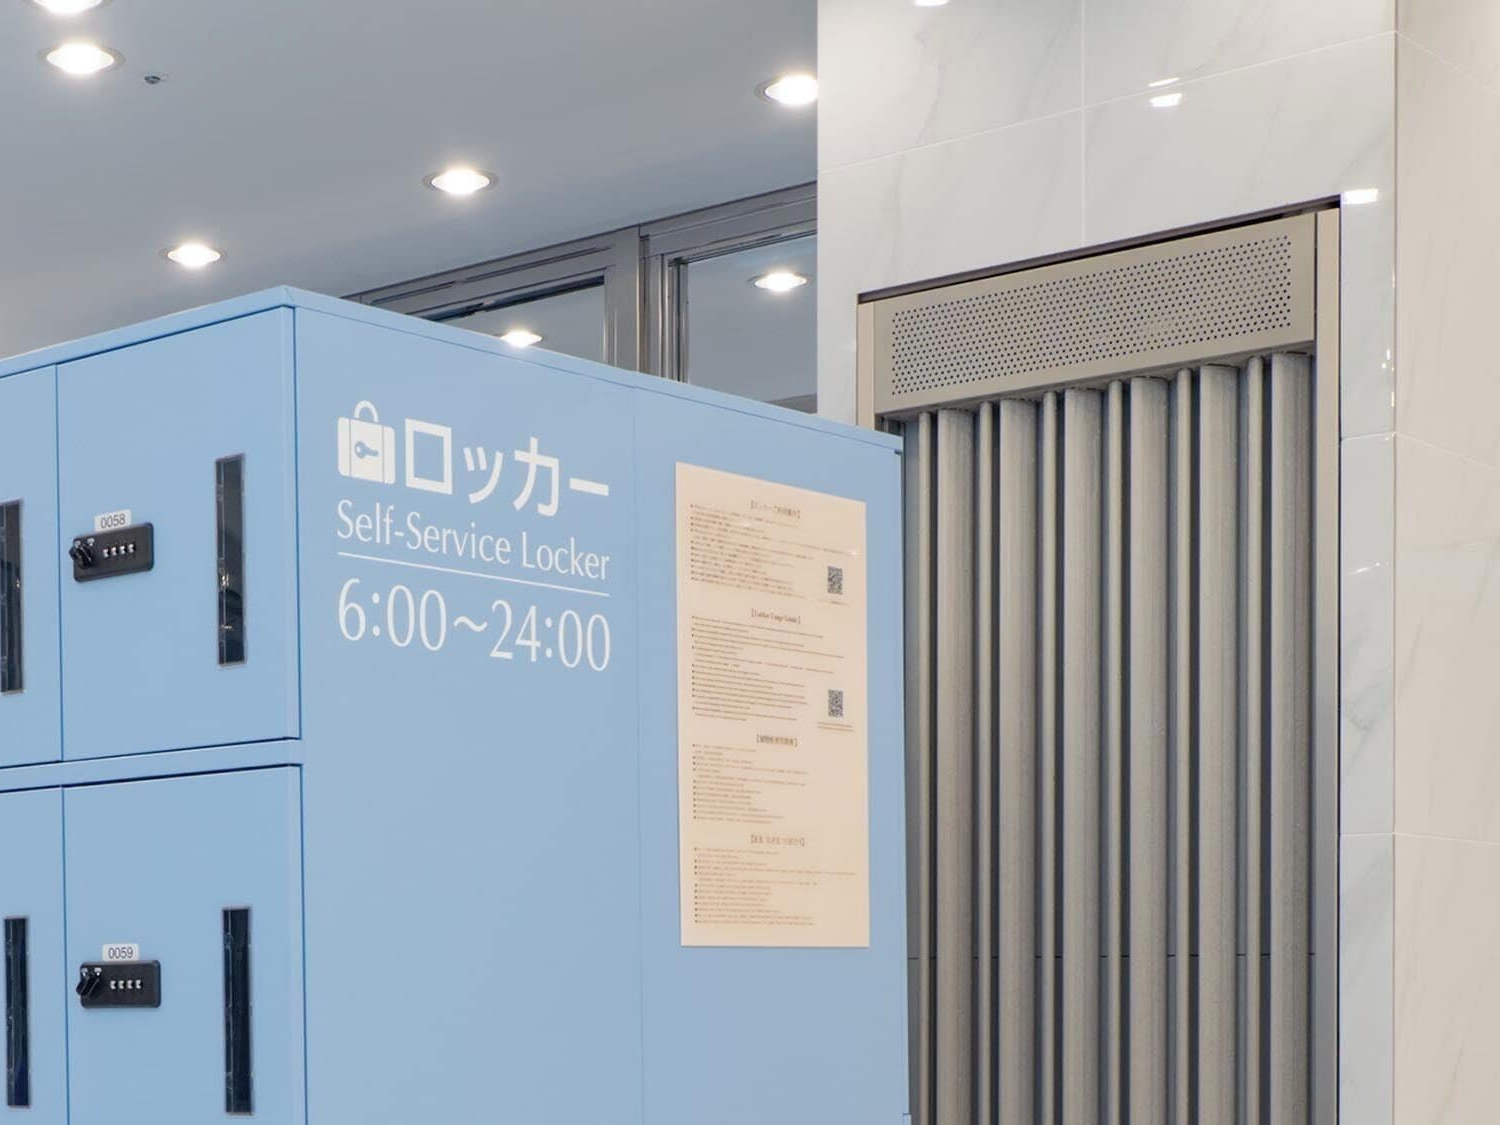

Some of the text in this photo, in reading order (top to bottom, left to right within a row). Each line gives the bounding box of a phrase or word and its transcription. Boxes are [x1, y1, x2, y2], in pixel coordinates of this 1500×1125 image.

[405, 418, 609, 517] ロッカー
[100, 513, 126, 528] 0058
[337, 499, 610, 580] Self-Service Locker
[108, 947, 133, 959] 0059
